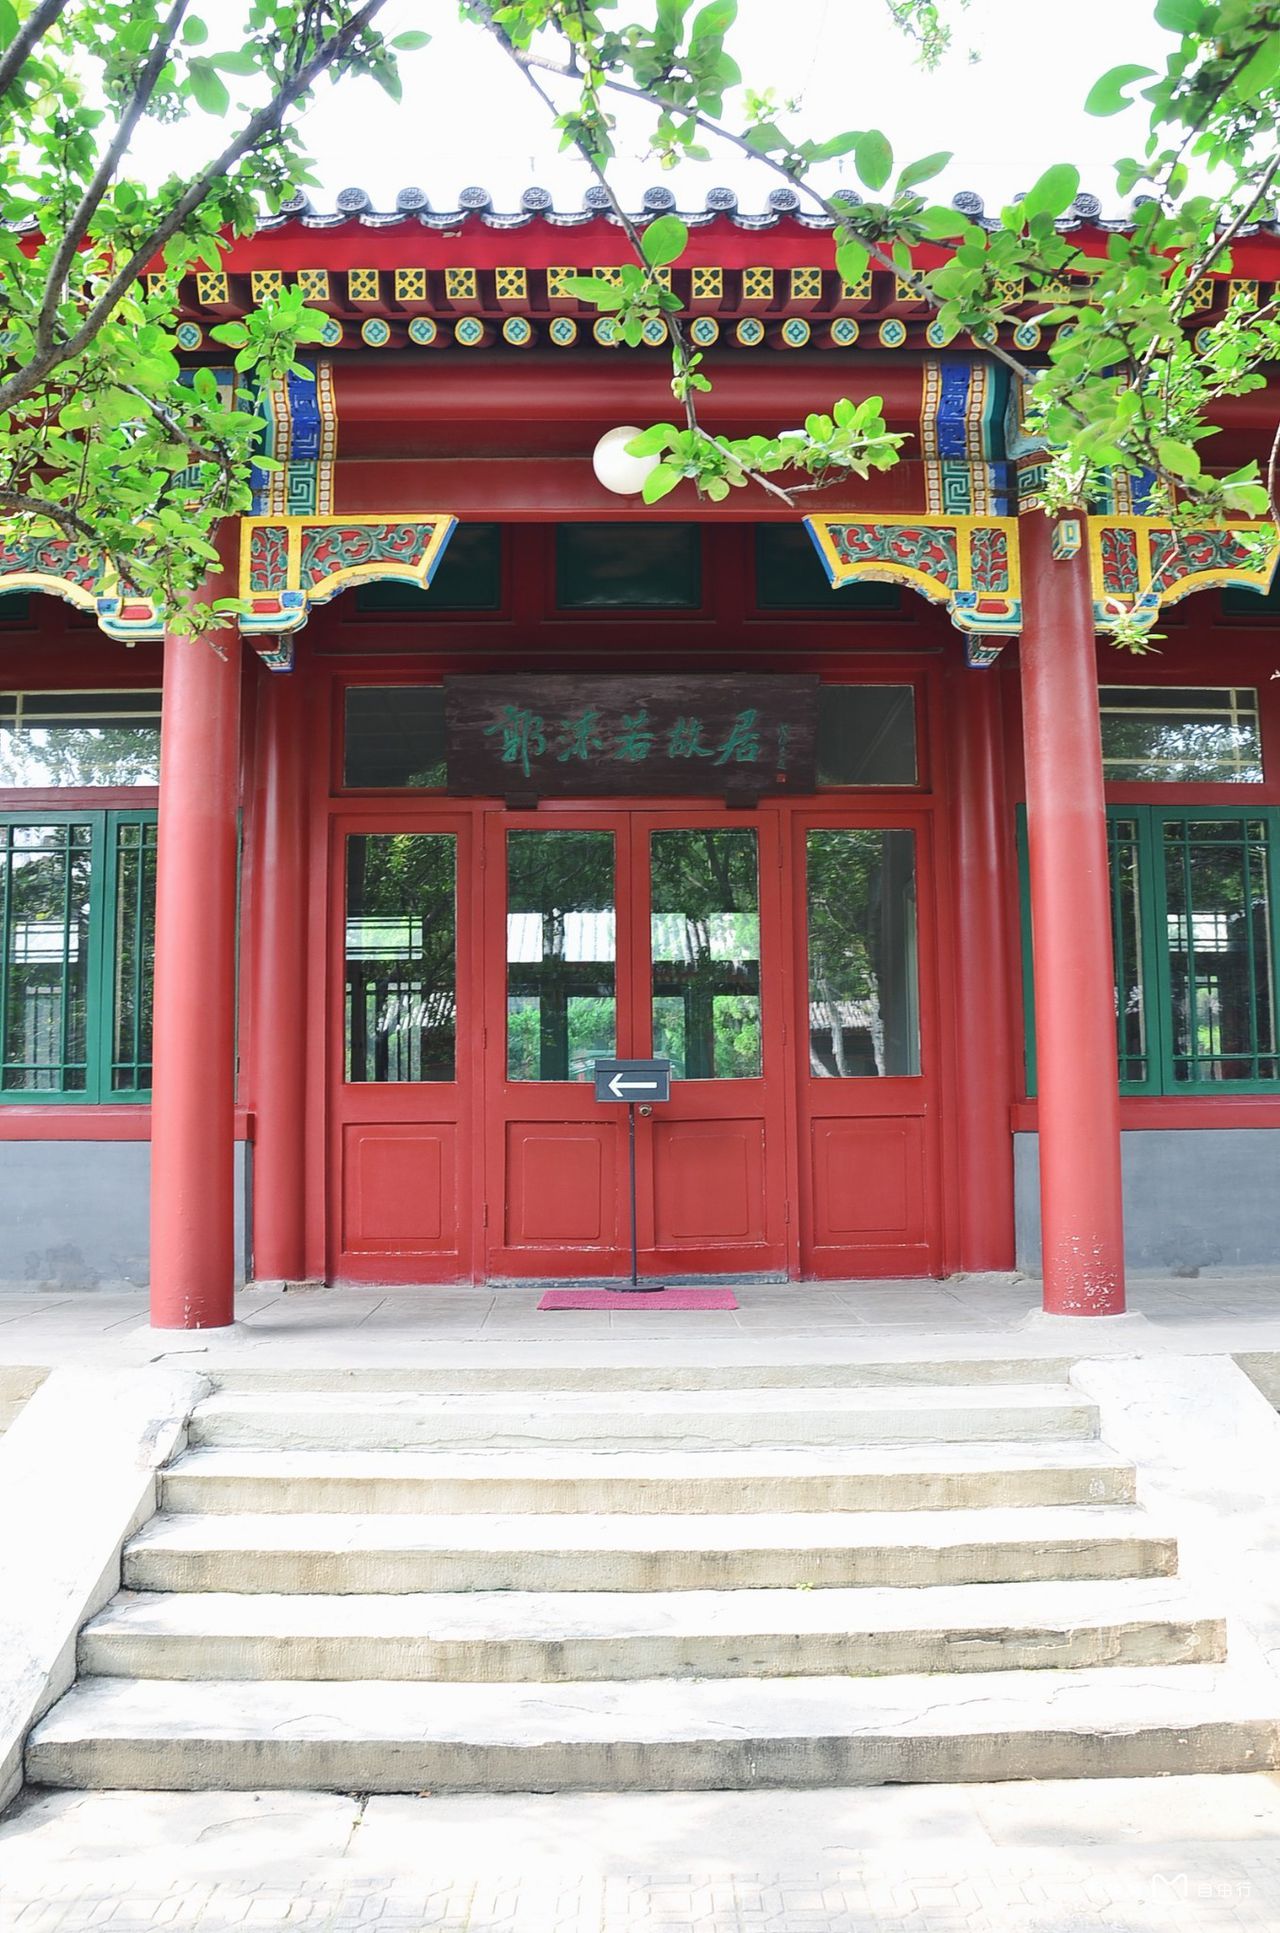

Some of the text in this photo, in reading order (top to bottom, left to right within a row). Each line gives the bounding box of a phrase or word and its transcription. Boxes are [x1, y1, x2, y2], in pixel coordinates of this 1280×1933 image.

[483, 705, 761, 777] 郭沫若故居
